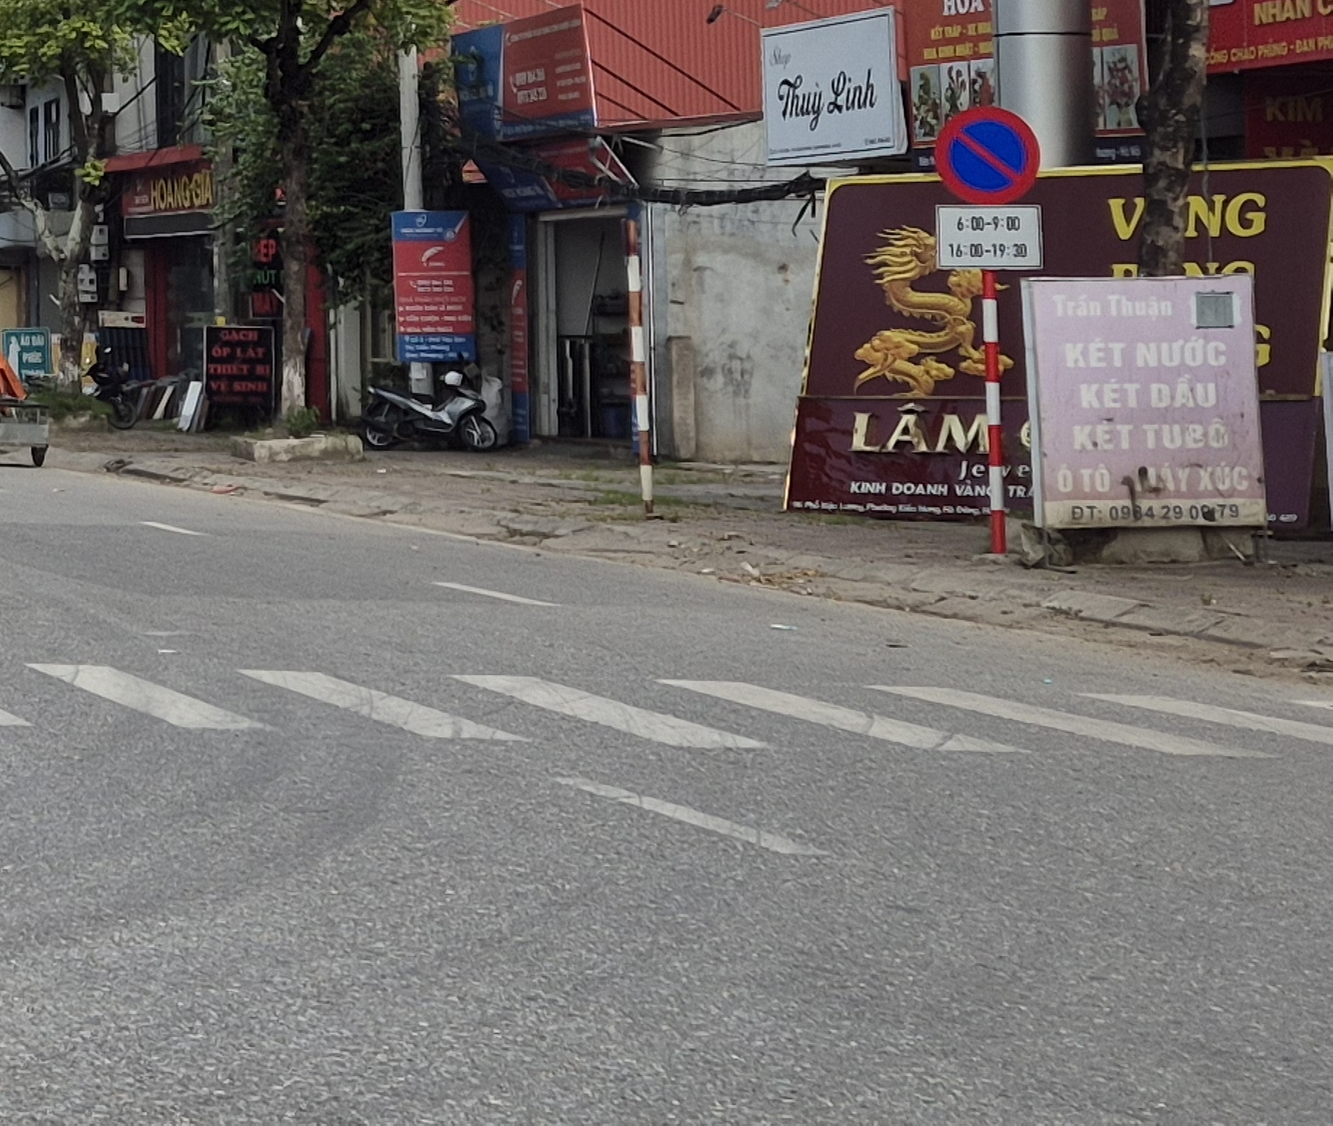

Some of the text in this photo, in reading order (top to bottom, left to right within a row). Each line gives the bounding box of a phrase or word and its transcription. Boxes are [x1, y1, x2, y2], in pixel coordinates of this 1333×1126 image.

[827, 68, 877, 114] Linh
[1108, 192, 1267, 241] VNG
[1065, 335, 1227, 368] KÉT NƯỚC
[1080, 373, 1218, 409] KÉT DẦU
[849, 402, 990, 455] LÂM
[1073, 420, 1134, 451] KÉT
[850, 481, 886, 494] KINH
[891, 482, 948, 496] DOANH
[1199, 461, 1250, 491] XÚC
[1071, 505, 1103, 521] ĐT:
[1161, 505, 1183, 520] 29
[1217, 504, 1239, 519] 79
